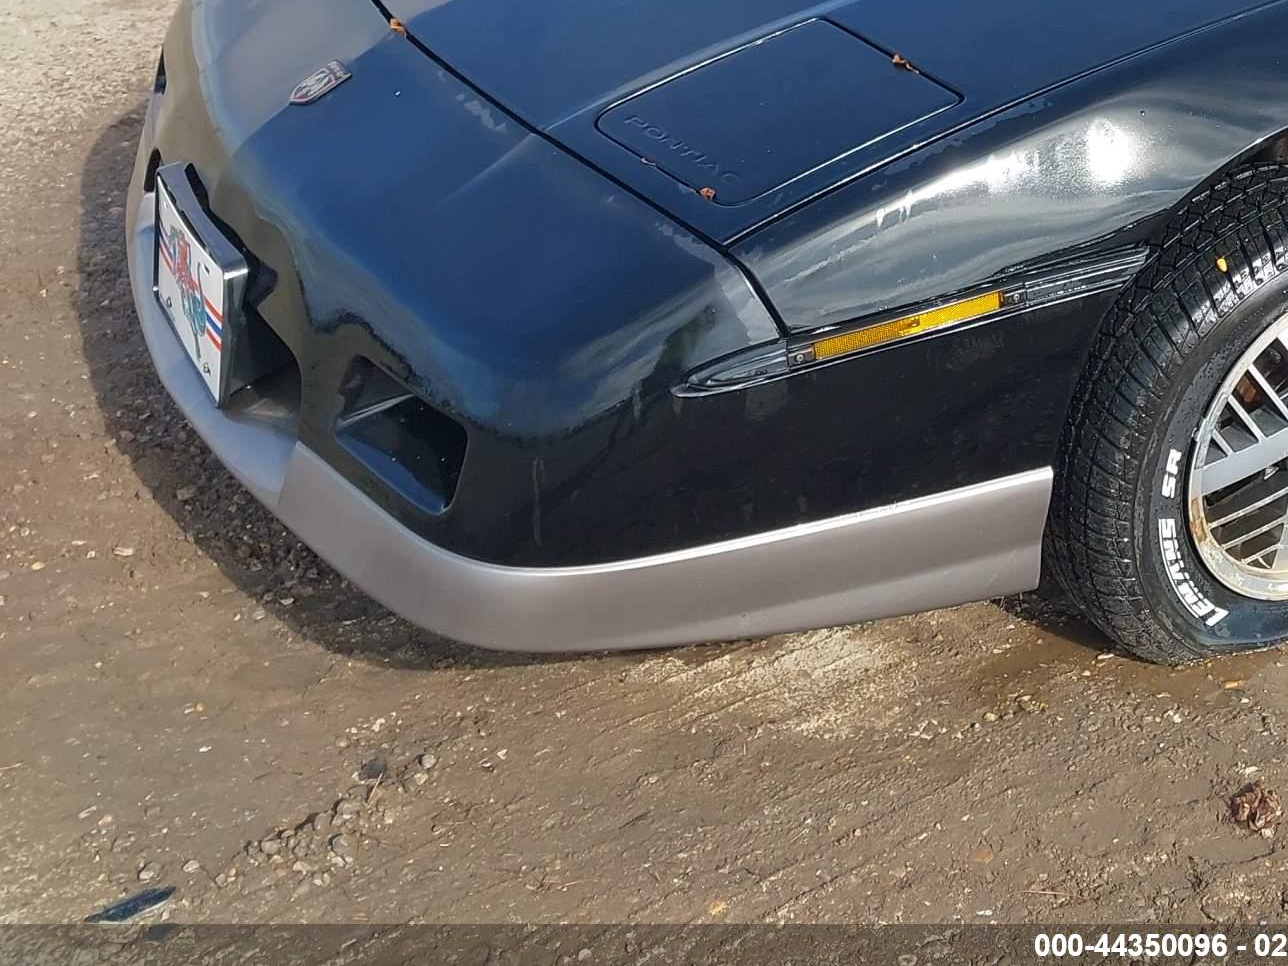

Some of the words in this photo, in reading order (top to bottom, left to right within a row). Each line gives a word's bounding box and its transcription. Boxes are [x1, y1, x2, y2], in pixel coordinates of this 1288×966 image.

[624, 115, 743, 184] PONTIAC
[1161, 448, 1183, 499] SR
[1158, 518, 1230, 627] LEMANS
